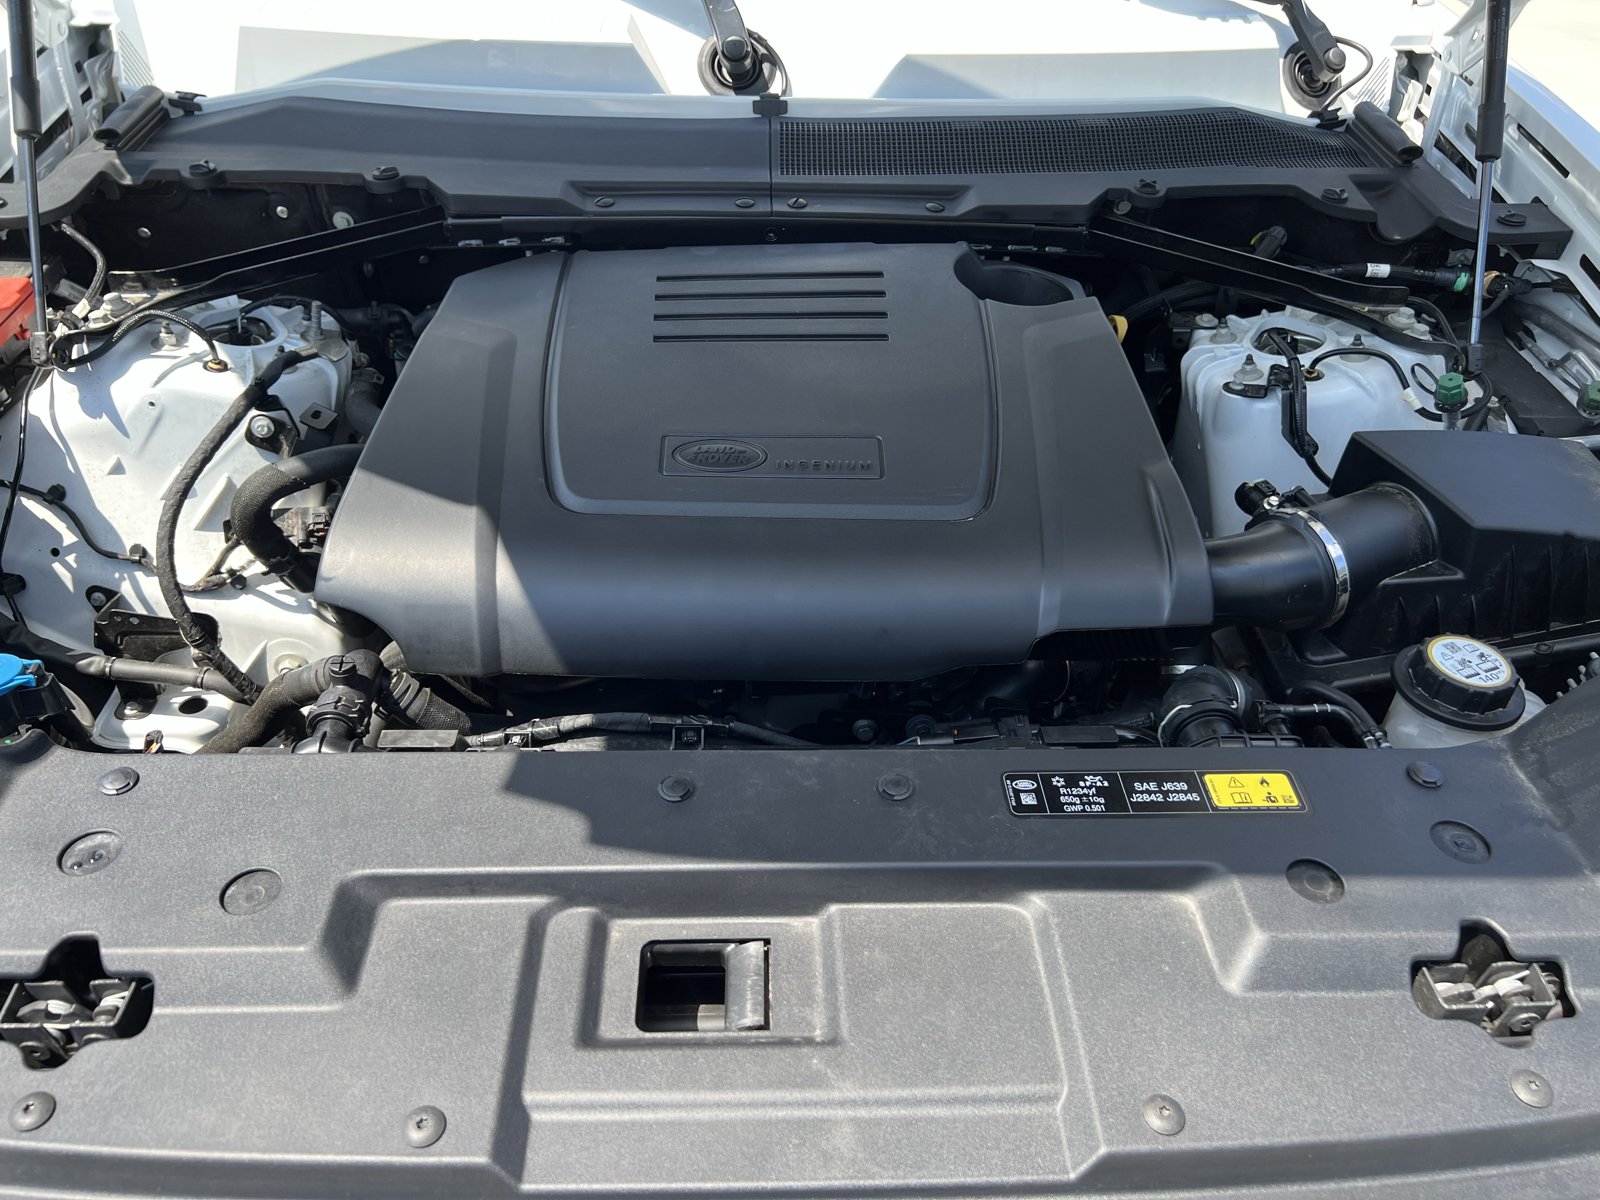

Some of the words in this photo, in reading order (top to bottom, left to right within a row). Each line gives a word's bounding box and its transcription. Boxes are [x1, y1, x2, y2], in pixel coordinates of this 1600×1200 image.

[775, 459, 872, 471] INGENIUM
[1479, 674, 1499, 683] 140
[1134, 782, 1159, 791] SAE
[1161, 782, 1188, 791] J639
[1059, 787, 1096, 796] R1234yf
[1060, 796, 1080, 804] 650g
[1130, 793, 1165, 802] J2842
[1166, 793, 1200, 801] J2845
[1063, 804, 1084, 812] GWP
[1084, 804, 1106, 812] 0.501
